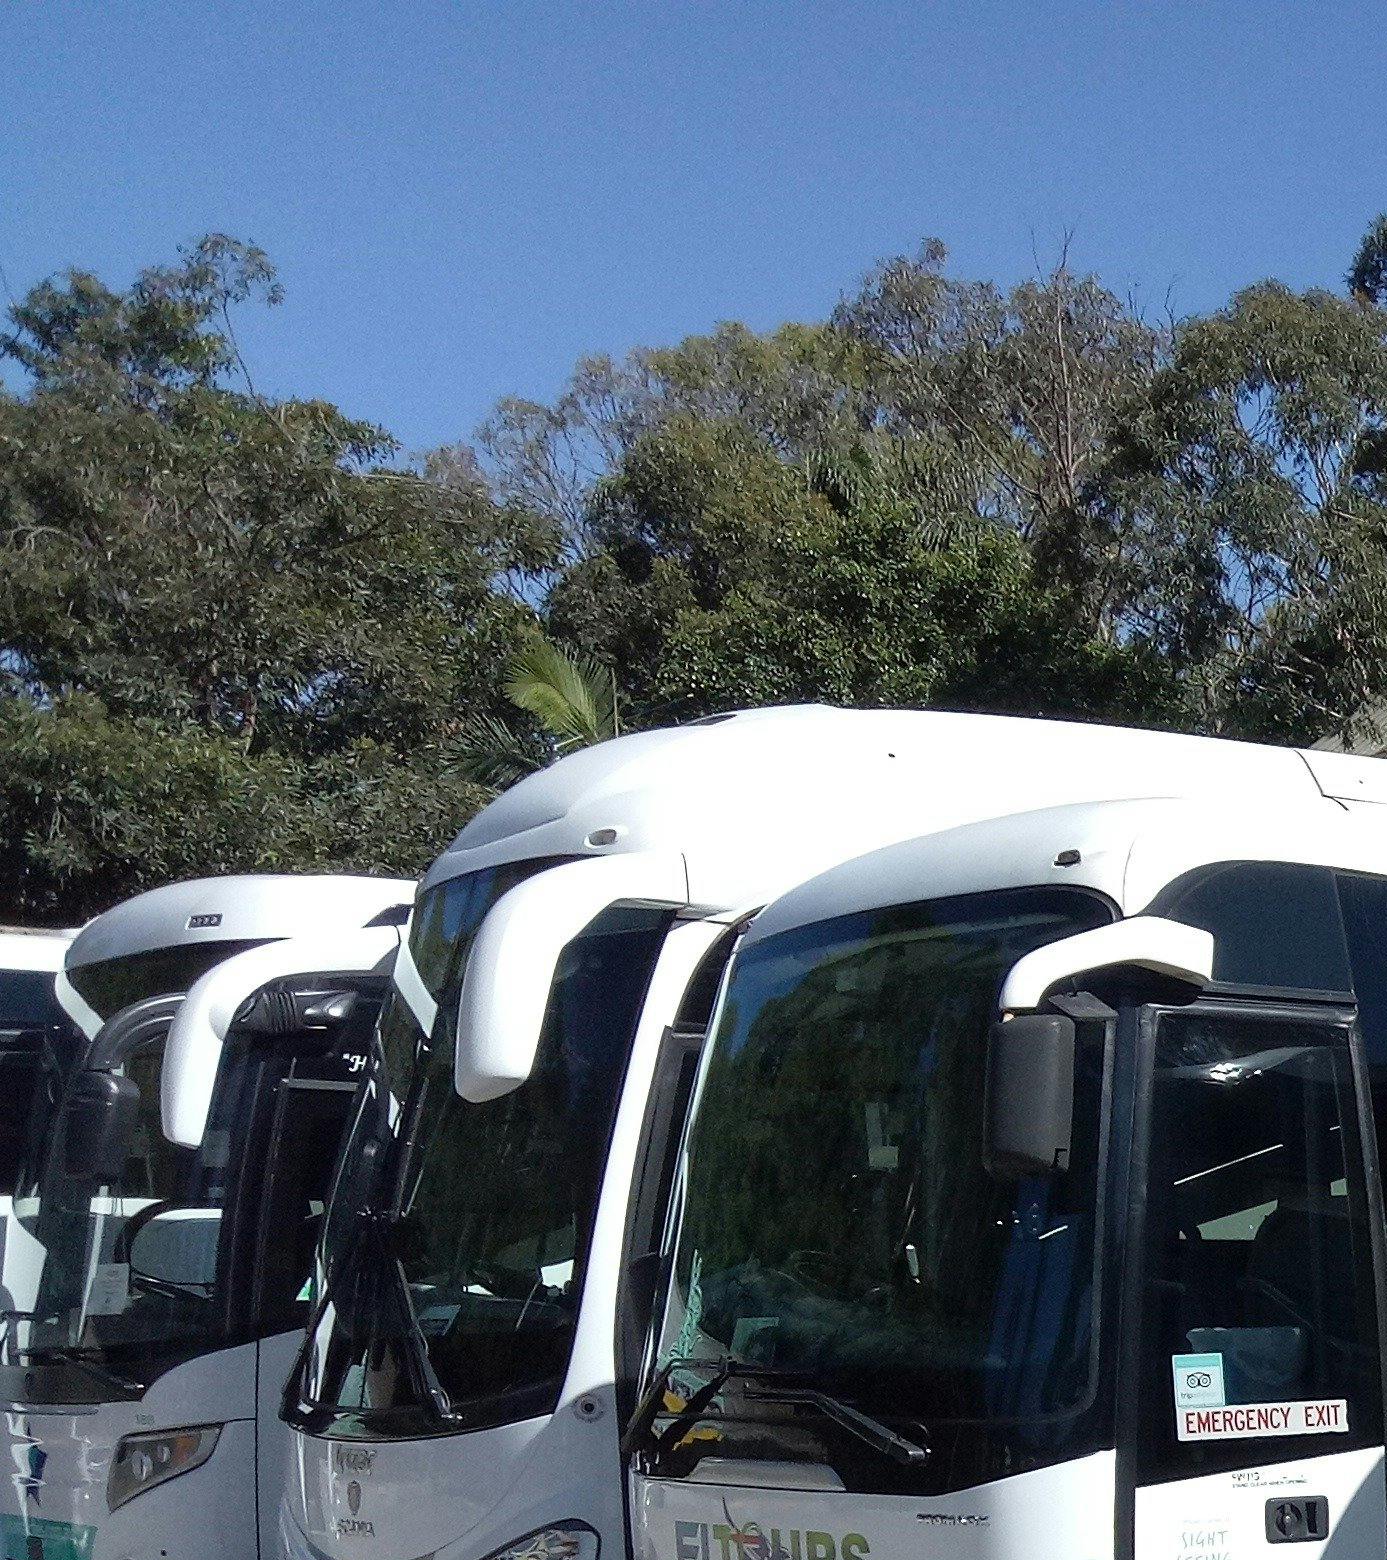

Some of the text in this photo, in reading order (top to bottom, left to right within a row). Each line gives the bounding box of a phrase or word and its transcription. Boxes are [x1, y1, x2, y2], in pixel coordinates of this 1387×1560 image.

[1185, 1404, 1341, 1434] EMERGENCY EXIT
[1181, 1530, 1229, 1549] SIGHT
